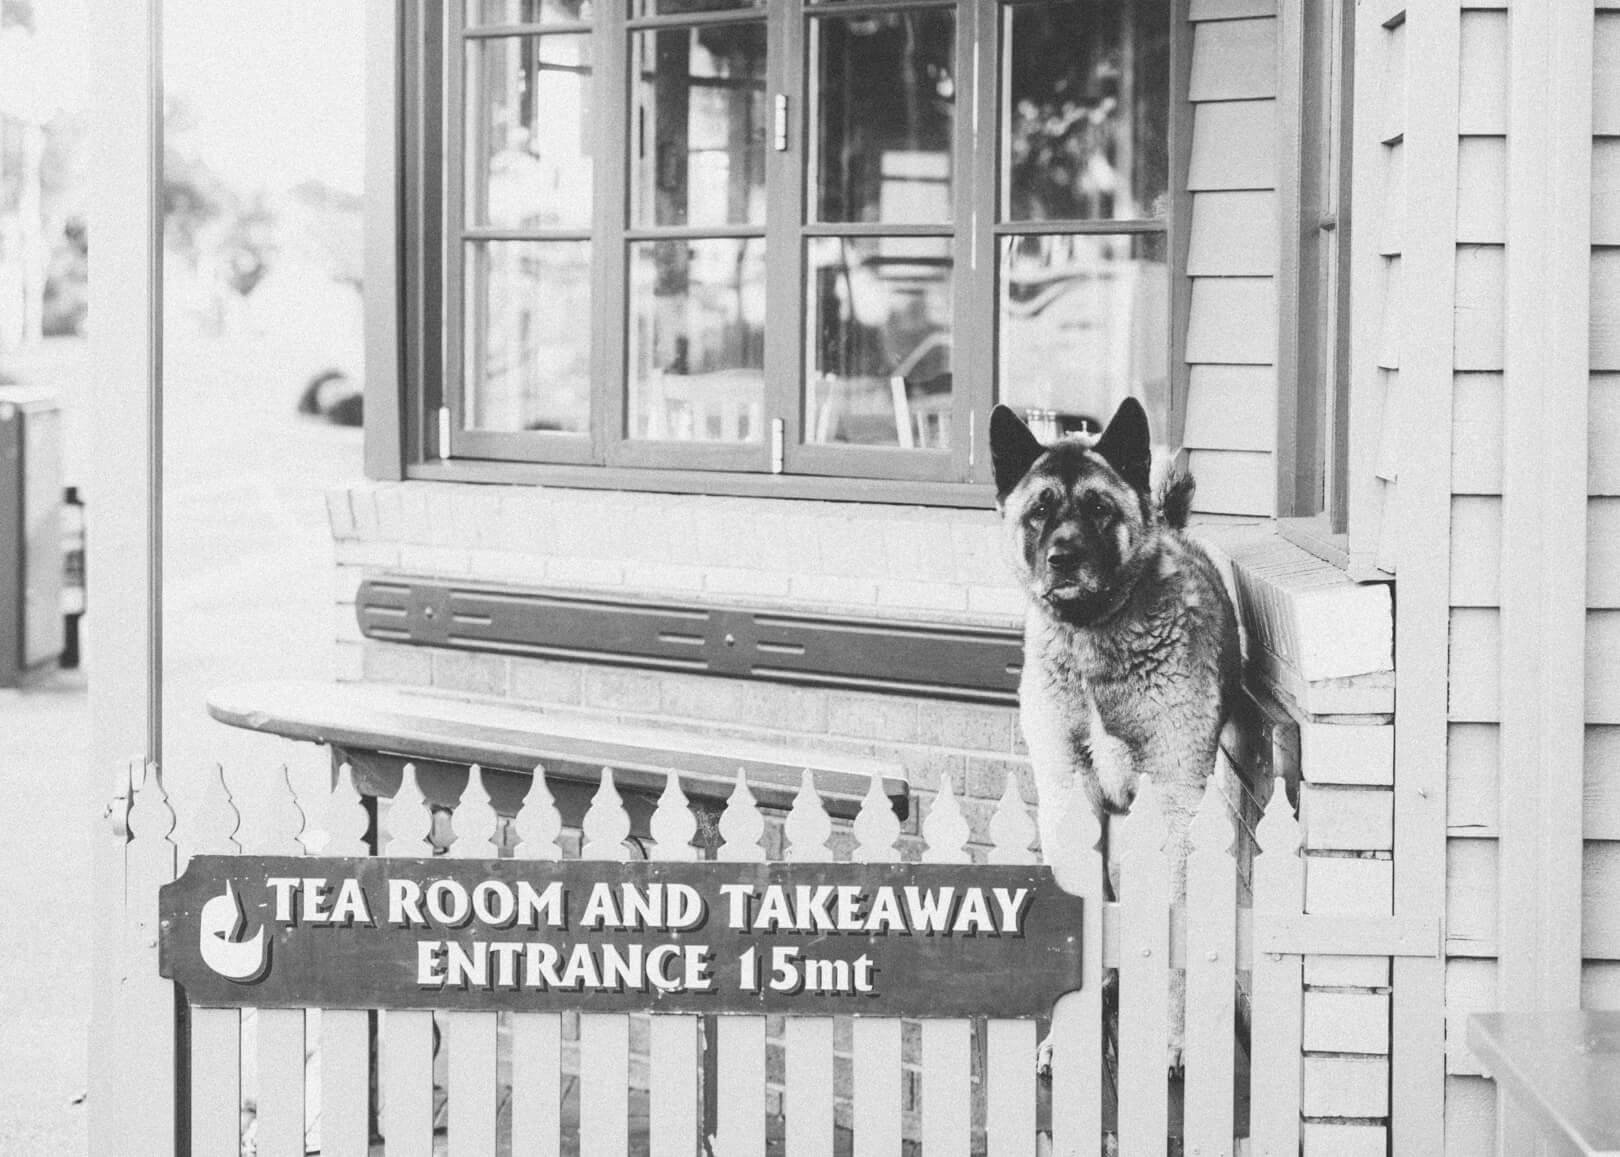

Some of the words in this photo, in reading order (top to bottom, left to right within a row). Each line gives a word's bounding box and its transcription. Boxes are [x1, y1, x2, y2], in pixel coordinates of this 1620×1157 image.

[266, 877, 371, 924] TEA
[388, 879, 564, 928] ROOM
[580, 881, 703, 929] AND
[719, 884, 1029, 934] TAKEAWAY
[416, 940, 711, 991] ENTRANCE
[738, 945, 875, 992] 15mt
